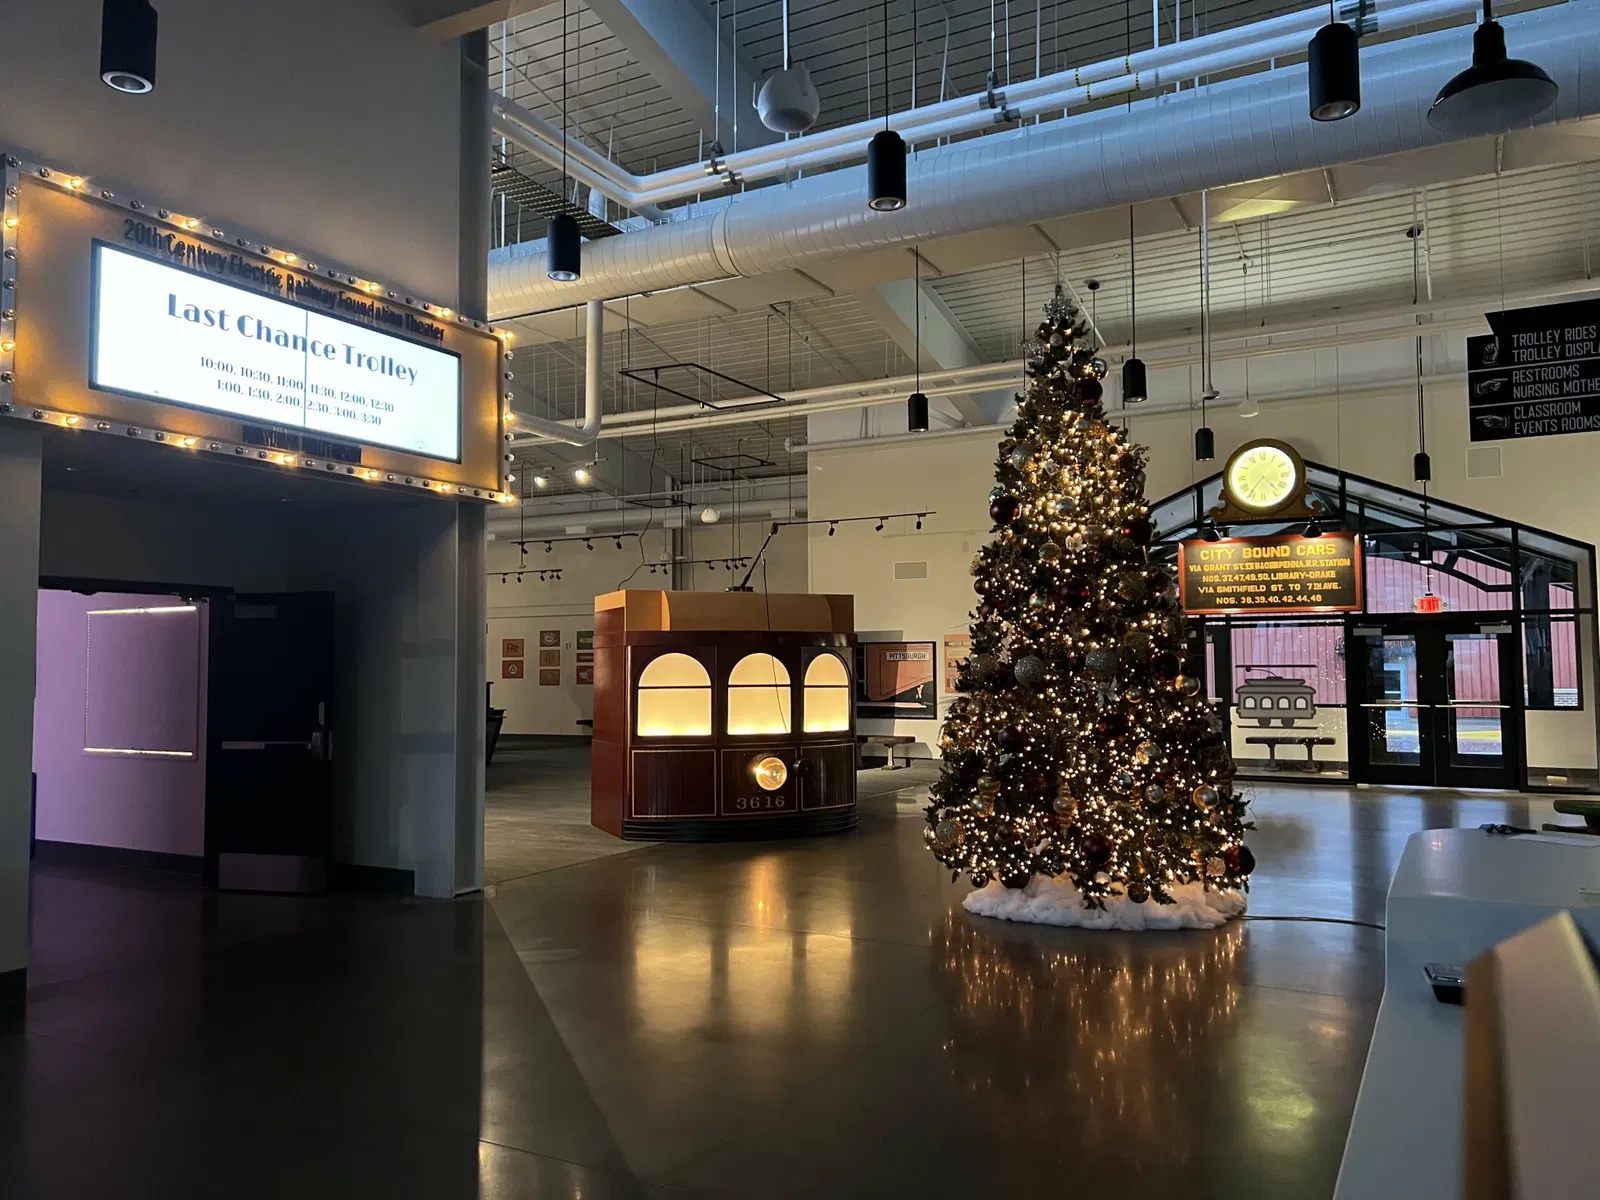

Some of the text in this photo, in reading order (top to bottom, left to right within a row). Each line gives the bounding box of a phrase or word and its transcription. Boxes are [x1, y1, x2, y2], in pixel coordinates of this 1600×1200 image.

[124, 218, 161, 249] 20th
[162, 233, 227, 274] Century
[405, 313, 445, 341] Theater
[168, 293, 419, 386] Last Chance Trolley
[1512, 325, 1597, 347] TROLLEY RIDES
[1512, 344, 1562, 363] TROLLEY
[1513, 364, 1580, 384] RESTROOMS
[1513, 377, 1600, 399] NURSING MOTHE
[370, 398, 395, 413] 12:30
[1514, 400, 1581, 420] CLASSROOM
[360, 412, 382, 426] 3:30
[1514, 414, 1600, 435] EVENTS ROOMS
[1200, 543, 1337, 561] CITY BOUND CARS
[1189, 564, 1202, 573] VIA
[1203, 563, 1231, 572] GRANT
[1198, 586, 1215, 594] VIA
[1216, 584, 1267, 593] SMITHFIELD
[1270, 583, 1284, 592] ST.
[1288, 583, 1301, 591] TO
[1216, 596, 1238, 605] NOS.
[888, 652, 926, 660] PITTSBURGH
[736, 795, 785, 809] 3616
